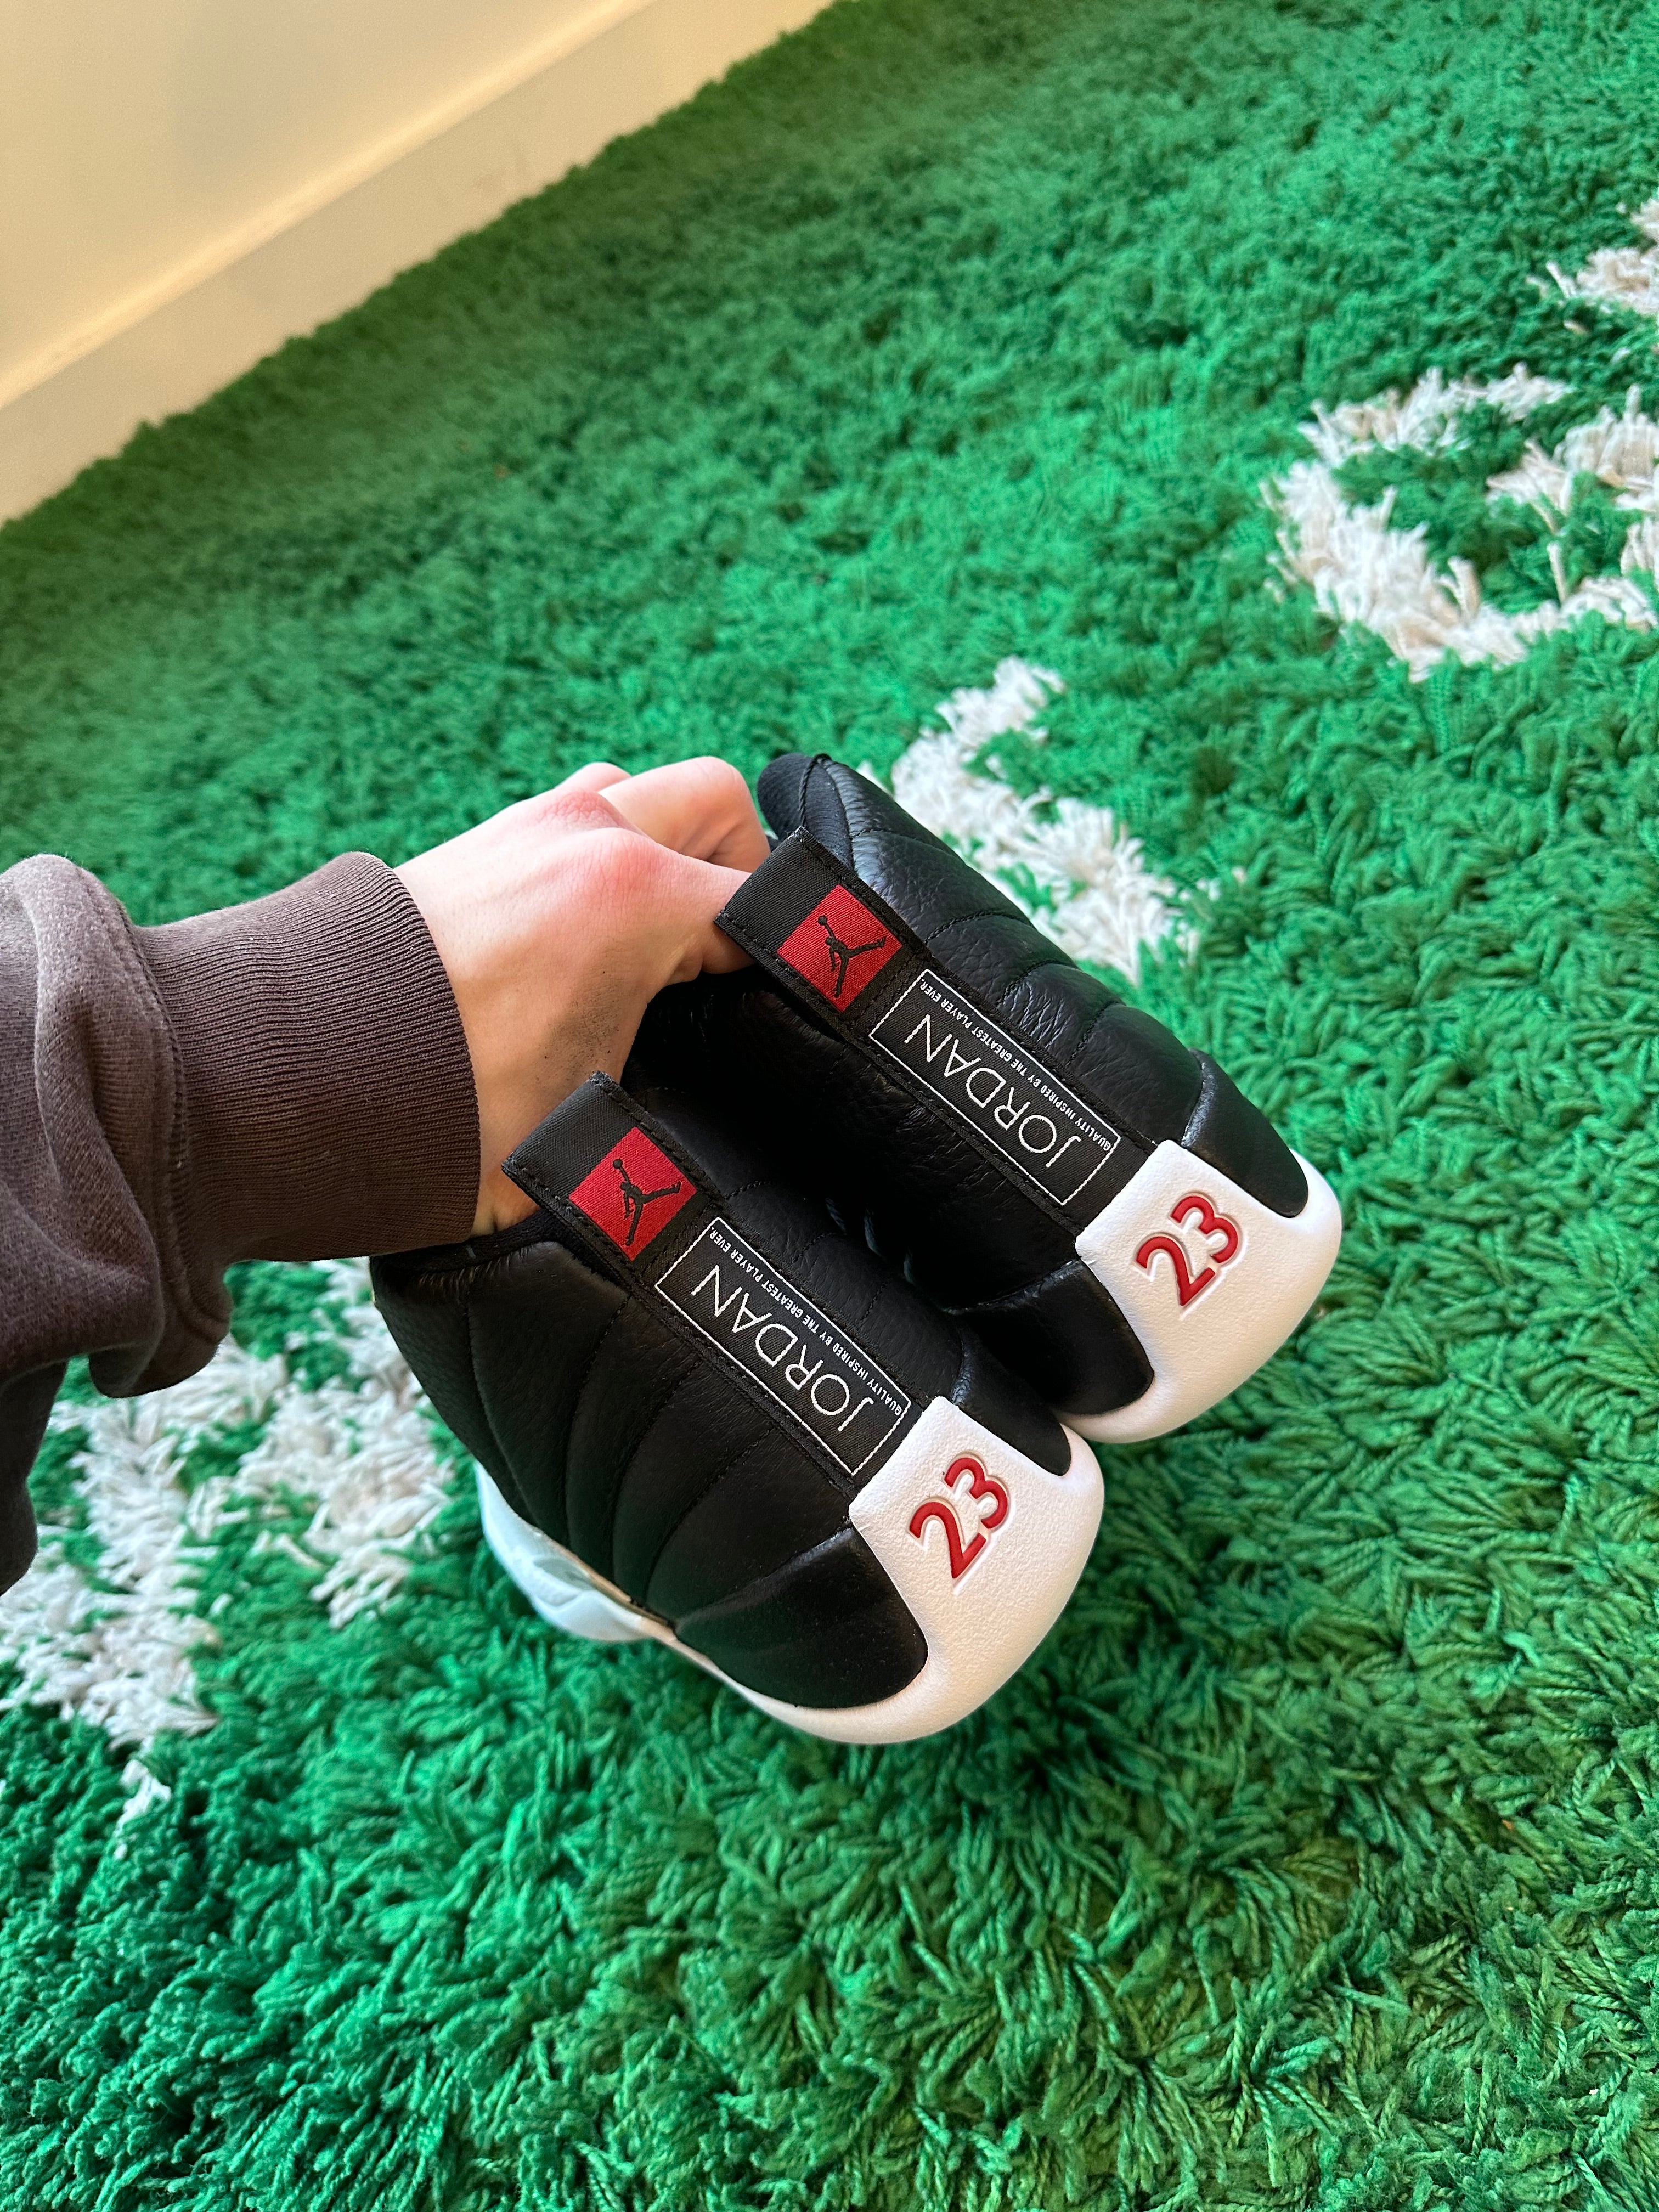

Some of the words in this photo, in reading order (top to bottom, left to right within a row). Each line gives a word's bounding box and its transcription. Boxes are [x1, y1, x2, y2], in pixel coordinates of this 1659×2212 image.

[919, 979, 941, 1002] EVER.
[941, 998, 973, 1029] PLAYER
[971, 1027, 1012, 1062] GREATEST
[1011, 1059, 1027, 1076] THE
[1028, 1075, 1041, 1087] BY
[904, 1014, 1081, 1168] JORDAN
[1041, 1085, 1076, 1119] INSPIRED
[1075, 1118, 1111, 1150] QUALITY
[709, 1227, 731, 1252] EVER.
[1135, 1195, 1239, 1307] 23
[731, 1249, 763, 1282] PLAYER
[761, 1280, 803, 1318] GREATEST
[802, 1315, 819, 1333] THE
[819, 1331, 833, 1346] BY
[691, 1265, 874, 1432] JORDAN
[833, 1343, 868, 1380] INSPIRED
[867, 1379, 902, 1415] QUALITY
[909, 1457, 1008, 1579] 23
